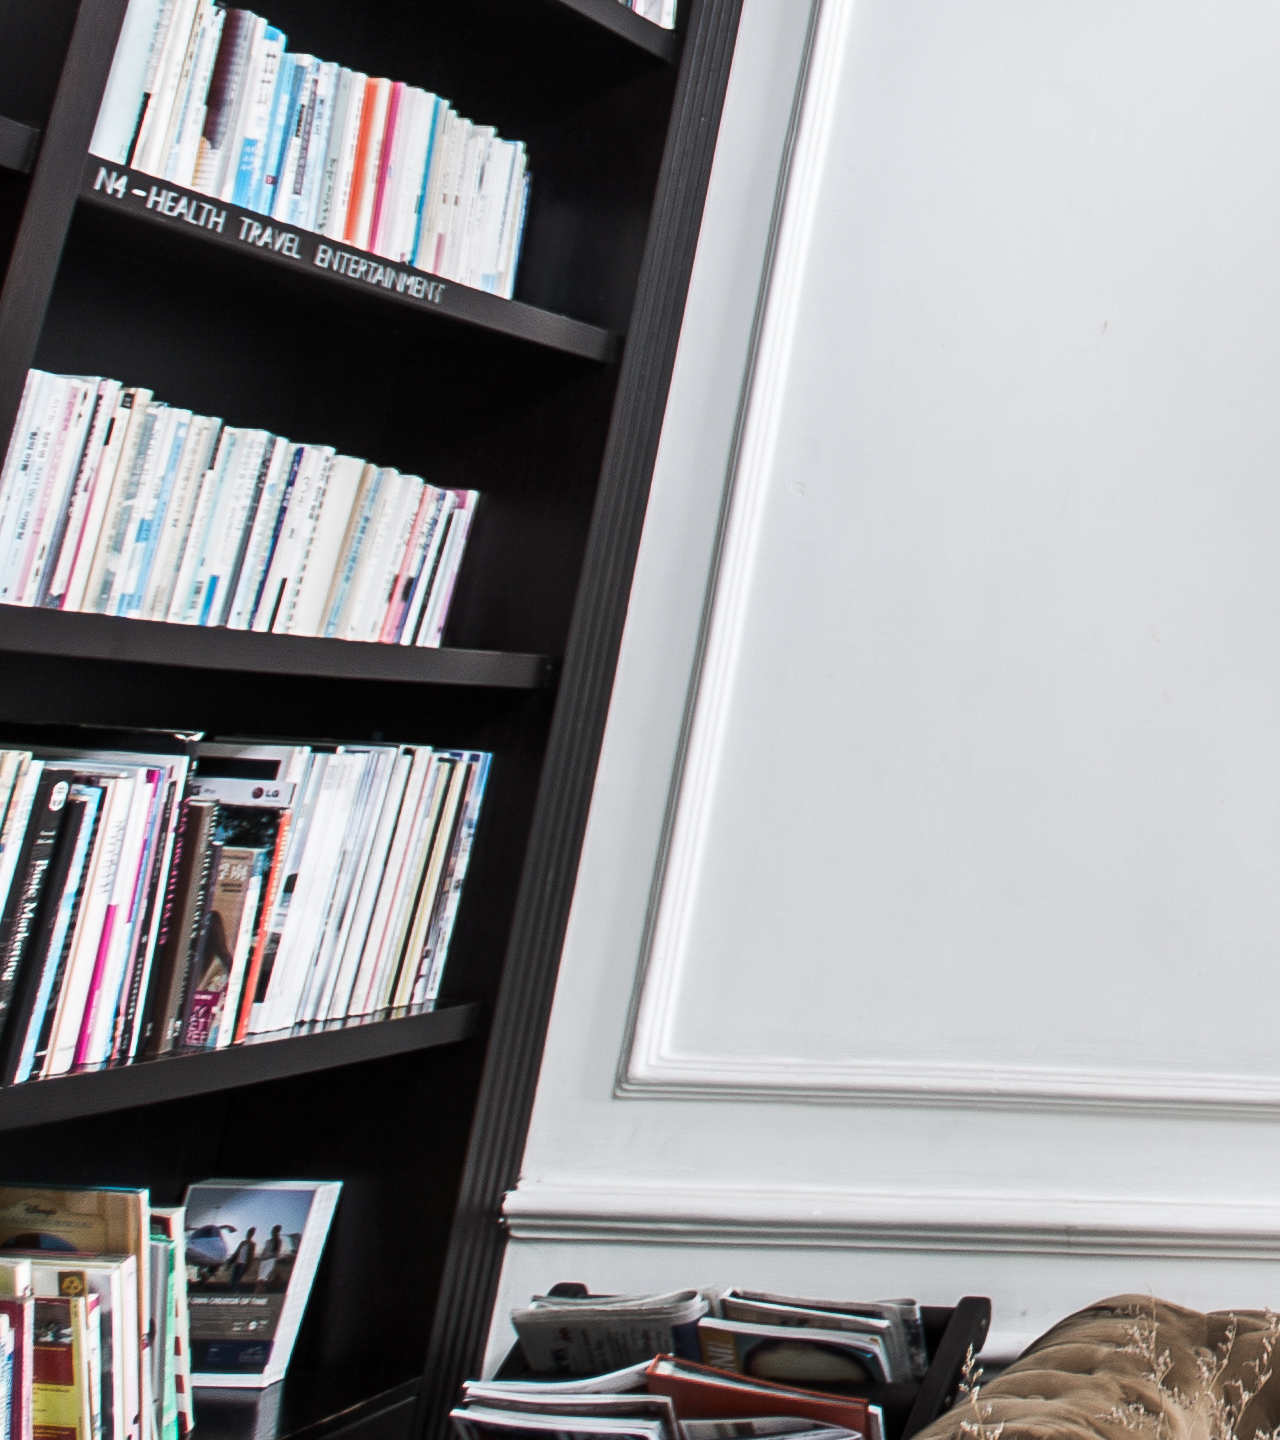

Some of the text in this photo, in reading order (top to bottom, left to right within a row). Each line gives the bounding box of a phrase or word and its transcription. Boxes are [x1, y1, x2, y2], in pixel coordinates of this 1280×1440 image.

[93, 166, 128, 199] N4
[146, 185, 227, 234] HEALTH
[239, 216, 301, 260] TRAVEL
[314, 244, 446, 304] ENTERTAINMENT
[265, 789, 280, 798] LG
[1, 902, 38, 982] Marketing
